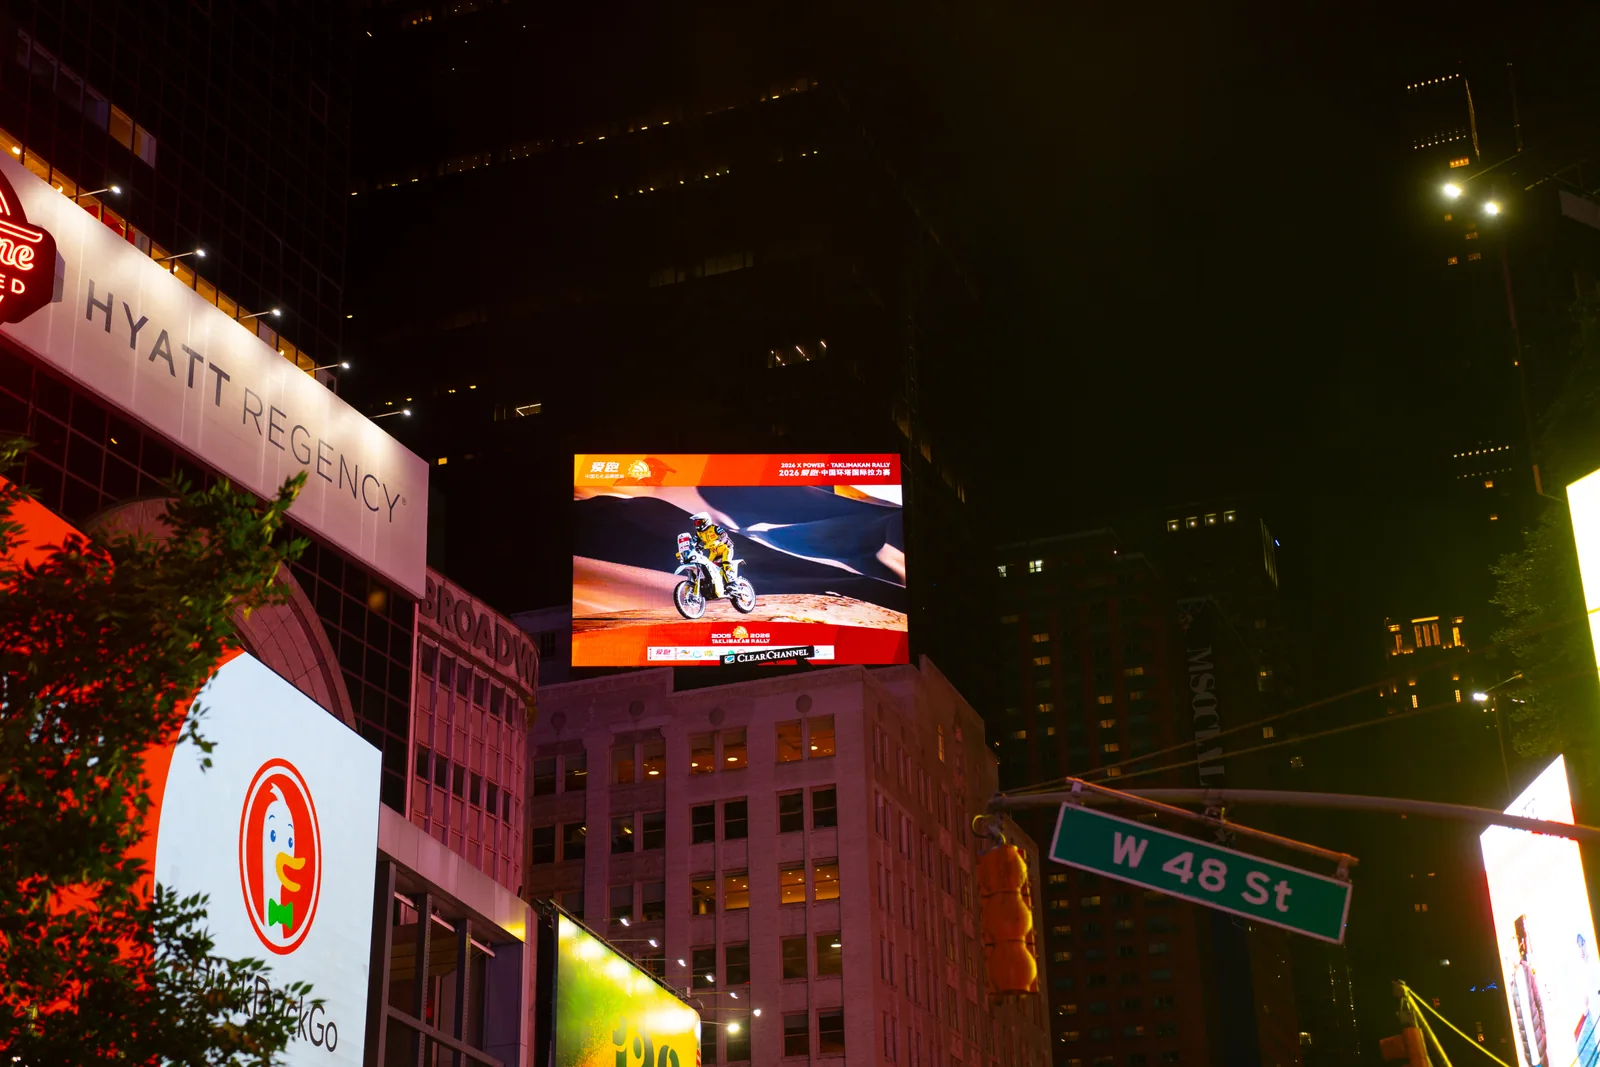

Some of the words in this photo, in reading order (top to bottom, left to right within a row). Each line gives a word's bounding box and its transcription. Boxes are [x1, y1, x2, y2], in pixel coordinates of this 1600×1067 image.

[85, 278, 231, 408] HYATT
[778, 469, 799, 477] 2026
[1113, 832, 1149, 868] W
[1162, 852, 1228, 892] 48
[1241, 871, 1293, 912] St
